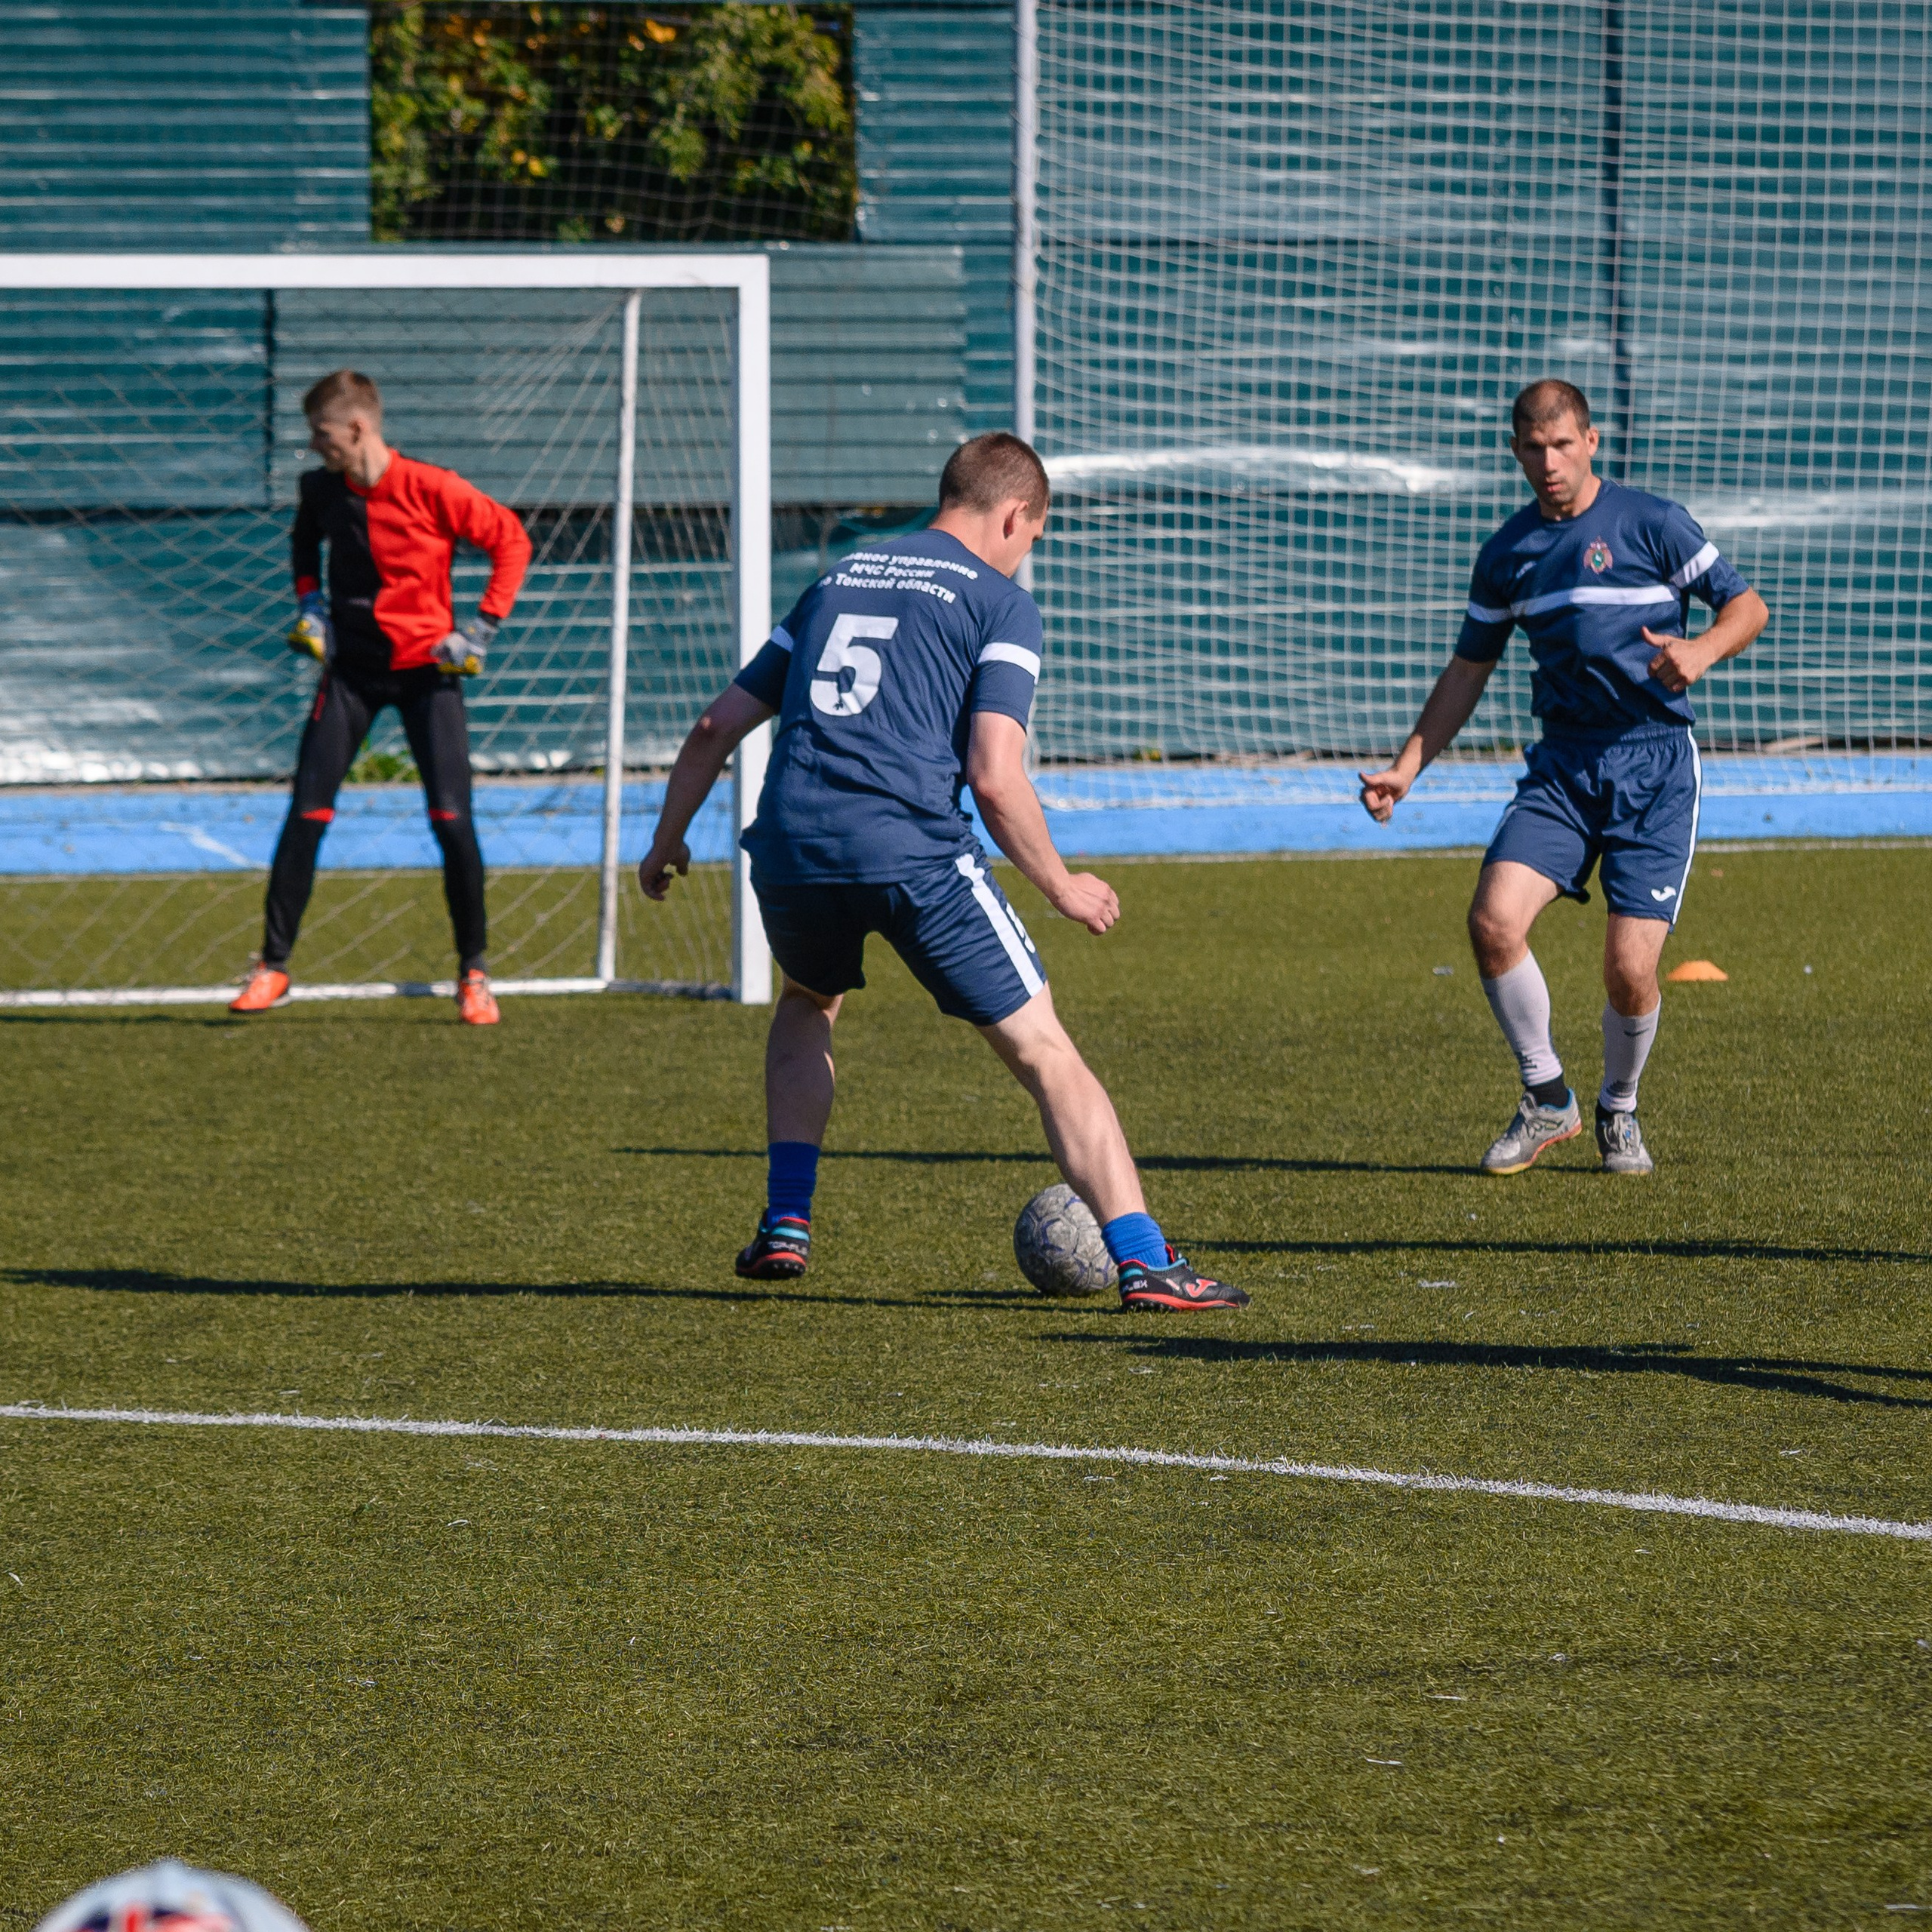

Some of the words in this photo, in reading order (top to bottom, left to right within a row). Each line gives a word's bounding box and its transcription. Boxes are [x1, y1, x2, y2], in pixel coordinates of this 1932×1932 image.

[849, 563, 884, 575] МЧС
[884, 566, 936, 578] России
[835, 573, 897, 589] Томской
[897, 578, 956, 604] области
[810, 614, 899, 716] 5
